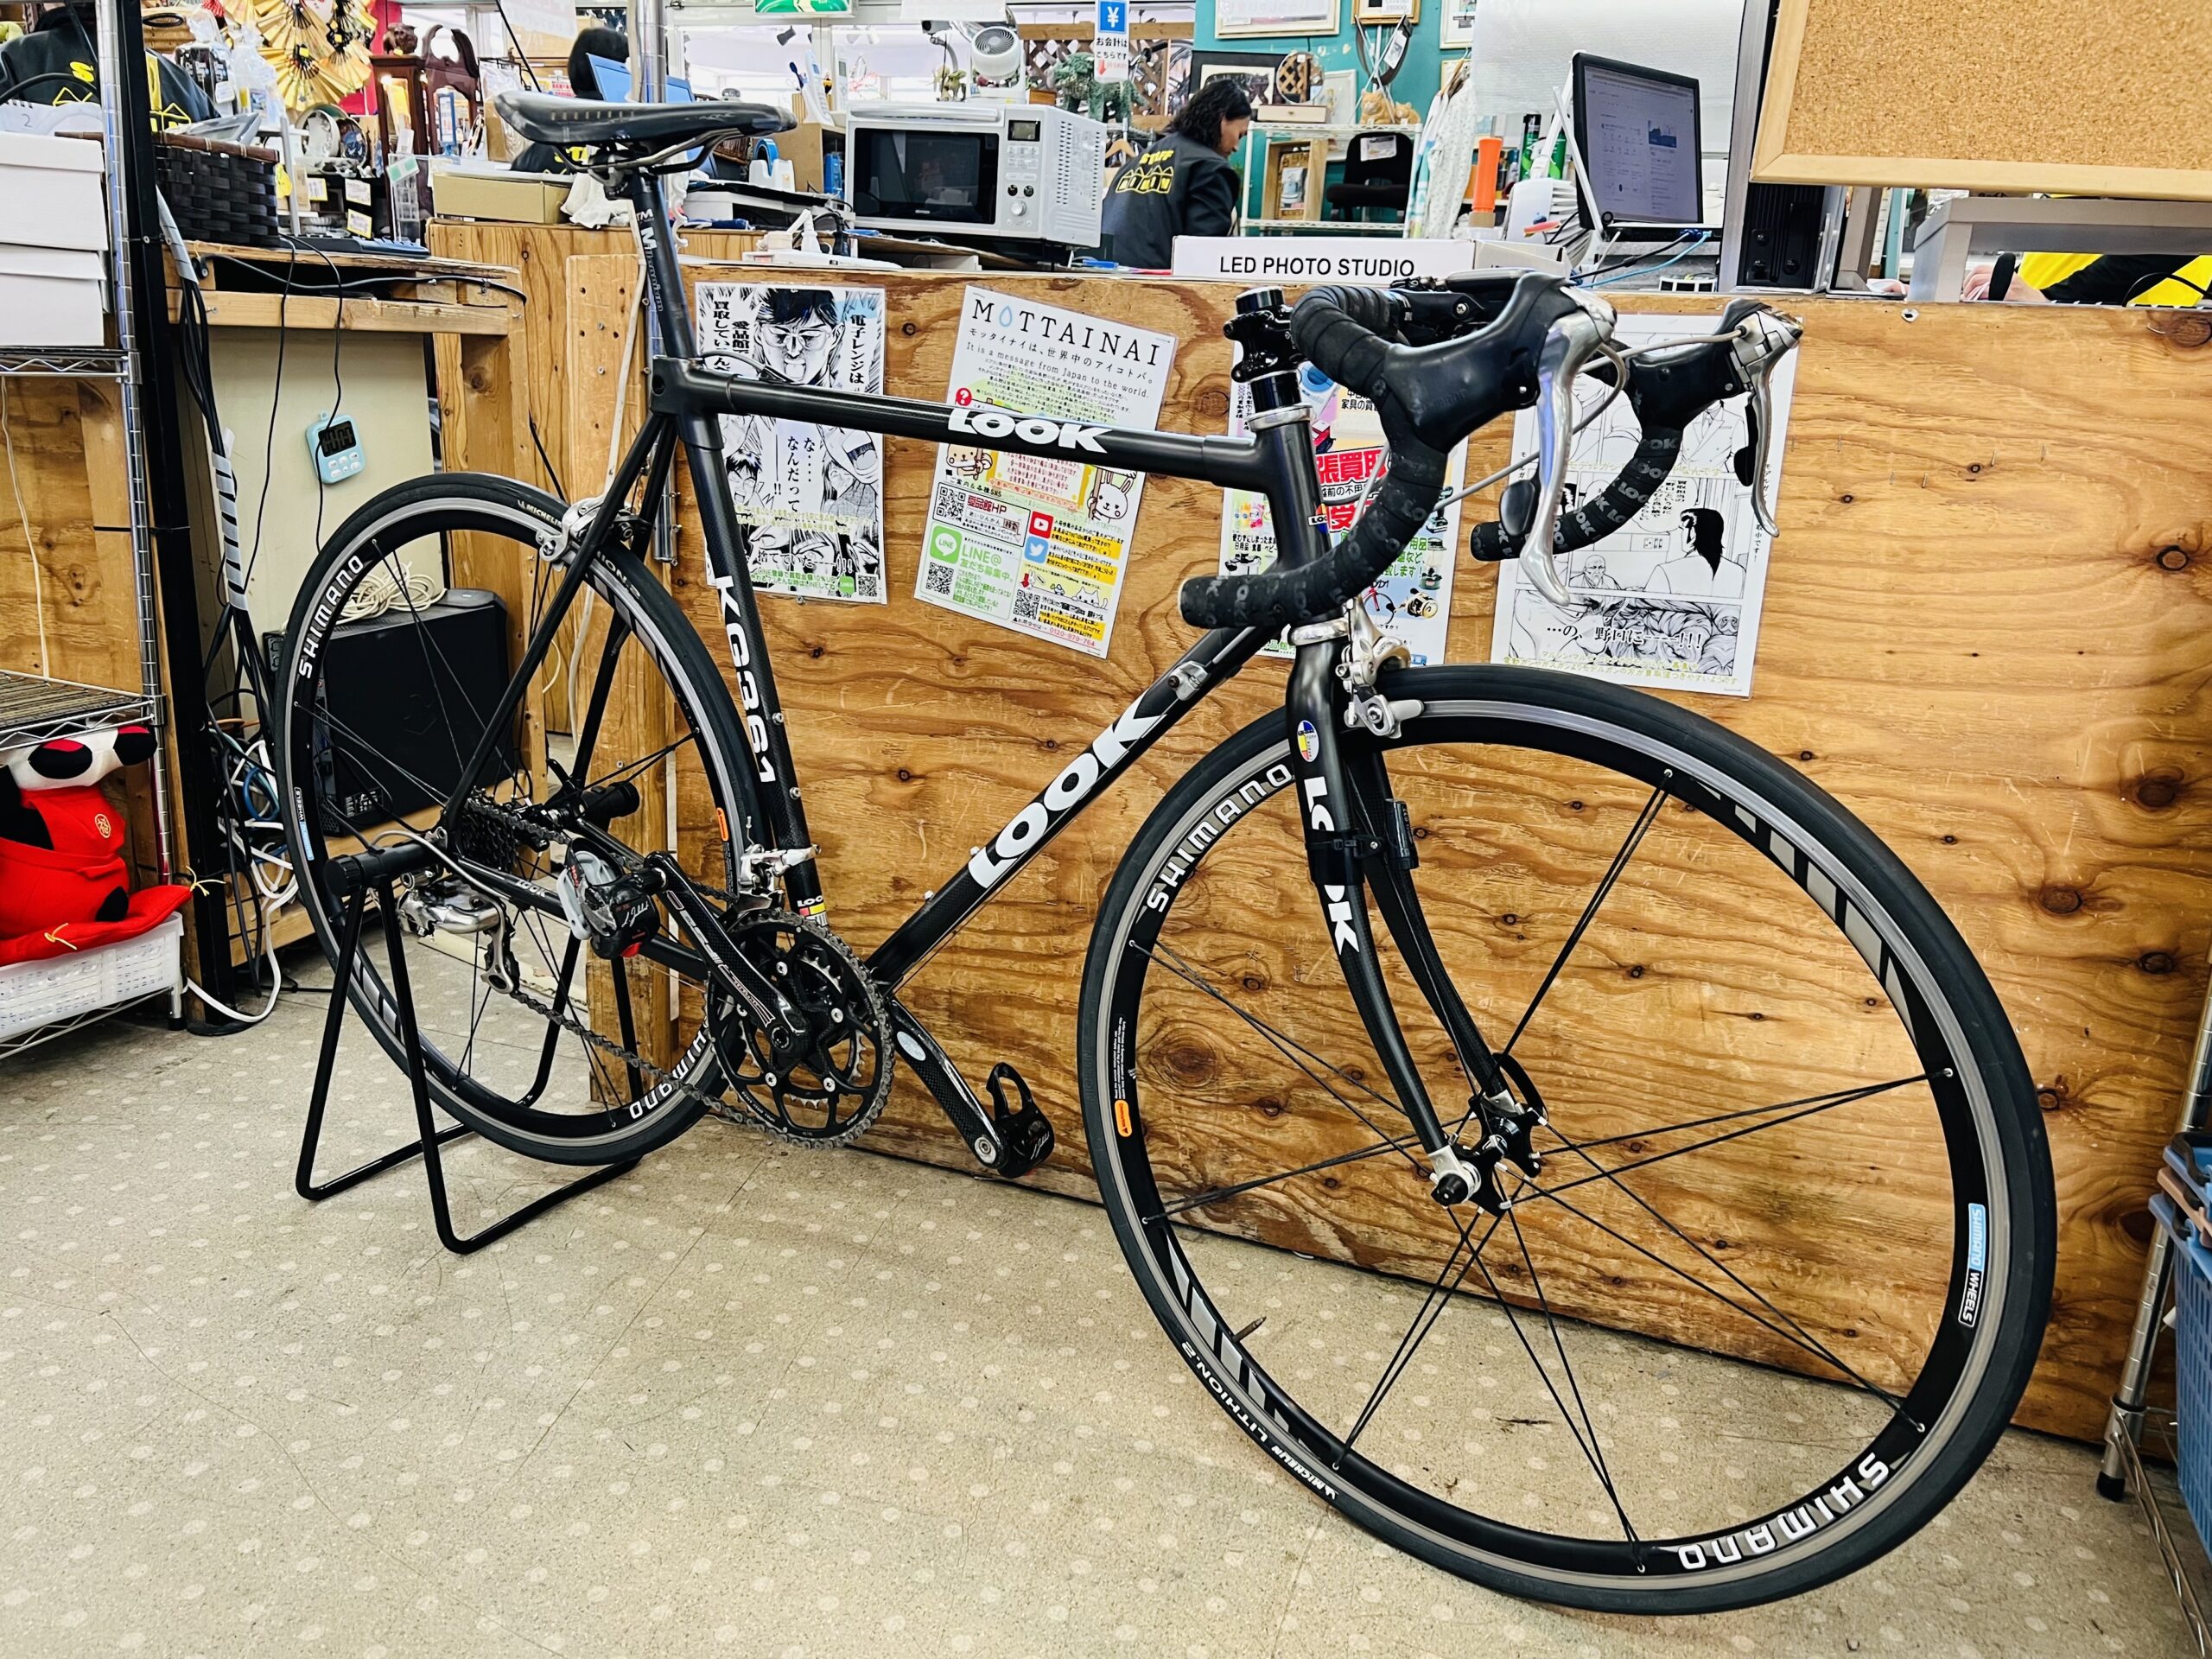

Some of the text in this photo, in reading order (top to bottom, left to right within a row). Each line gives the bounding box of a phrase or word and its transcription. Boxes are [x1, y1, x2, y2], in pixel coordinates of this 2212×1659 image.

[1096, 36, 1128, 48] お会計は
[1096, 52, 1127, 60] こちらです
[1220, 257, 1414, 277] LED PHOTO STUDIO
[966, 341, 974, 351] It
[976, 345, 984, 353] is
[998, 351, 1040, 367] message
[1039, 360, 1058, 372] from
[1063, 366, 1087, 385] Japan
[1090, 375, 1100, 385] to
[1104, 378, 1118, 390] the
[948, 408, 1112, 454] LOOK
[938, 537, 955, 550] LINE
[962, 543, 1002, 565] LINE@
[298, 555, 365, 679] SHIMANO
[716, 575, 776, 783] KG361
[968, 689, 1167, 888] LOOK
[1147, 764, 1294, 912] SHIMANO
[1963, 1209, 1982, 1322] SHIMANO WHEELS
[1182, 1341, 1268, 1443] LITHION.2
[1272, 1446, 1325, 1491] MICHELIN
[1678, 1452, 1891, 1571] SHIMANO
